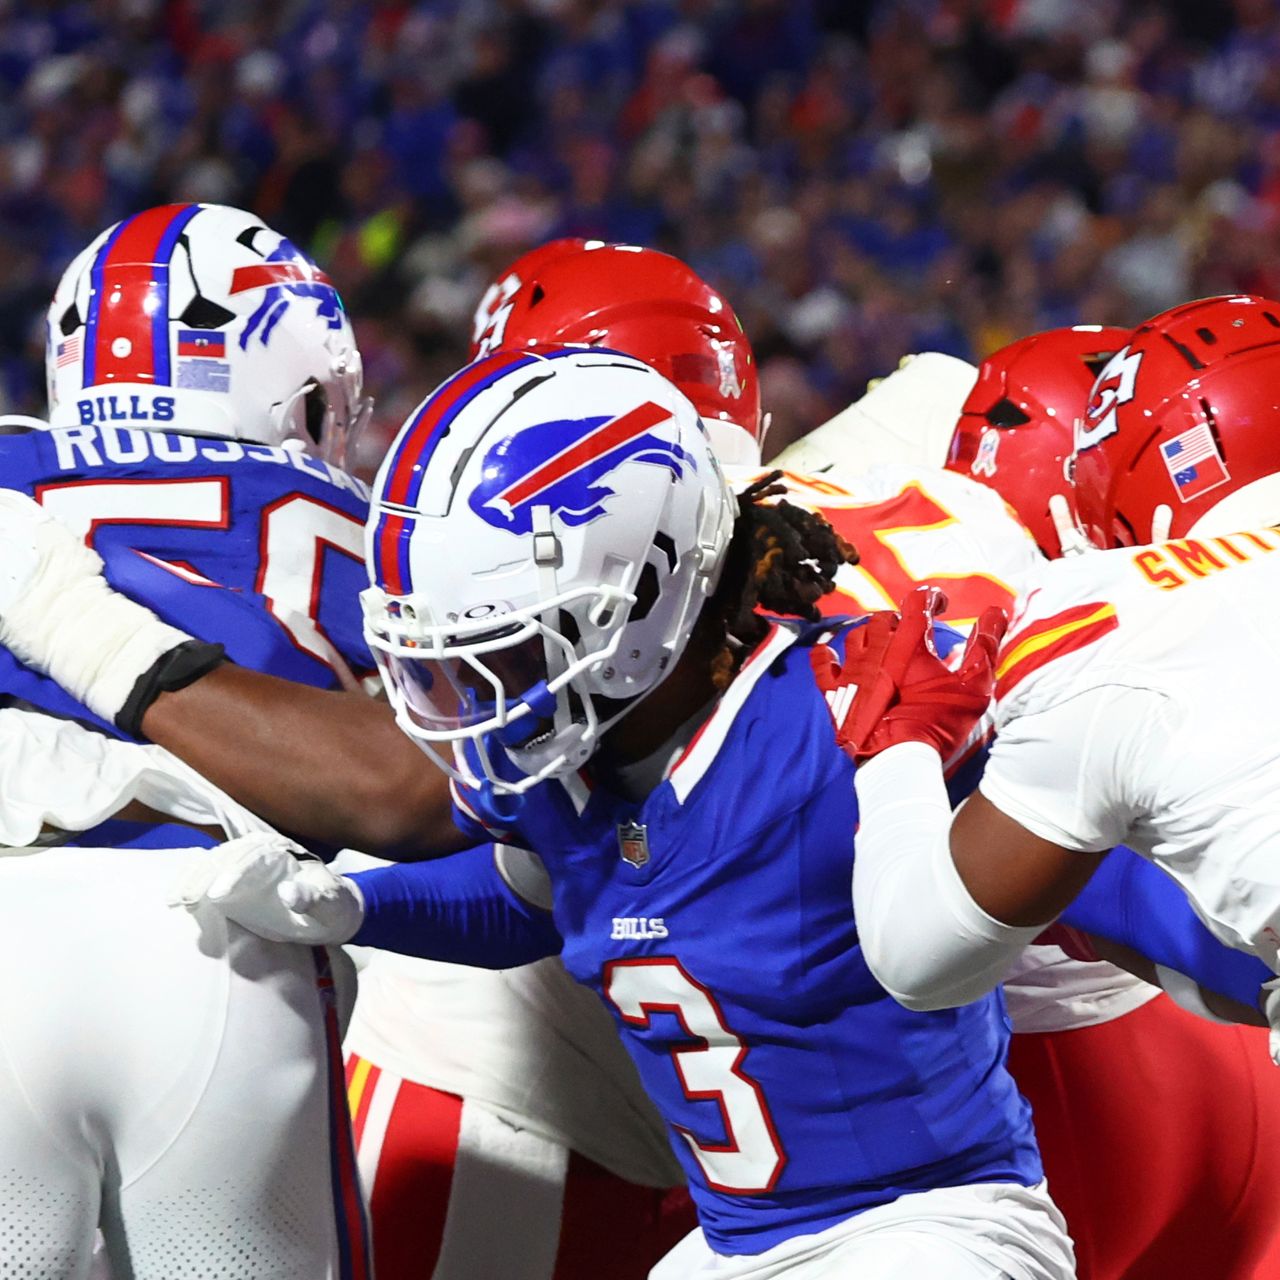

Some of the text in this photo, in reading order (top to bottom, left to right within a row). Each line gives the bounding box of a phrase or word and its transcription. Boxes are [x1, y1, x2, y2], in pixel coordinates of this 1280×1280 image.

[77, 396, 176, 426] BILLS
[51, 424, 372, 503] ROUEA
[610, 917, 669, 940] BILLS
[603, 956, 788, 1196] 3
